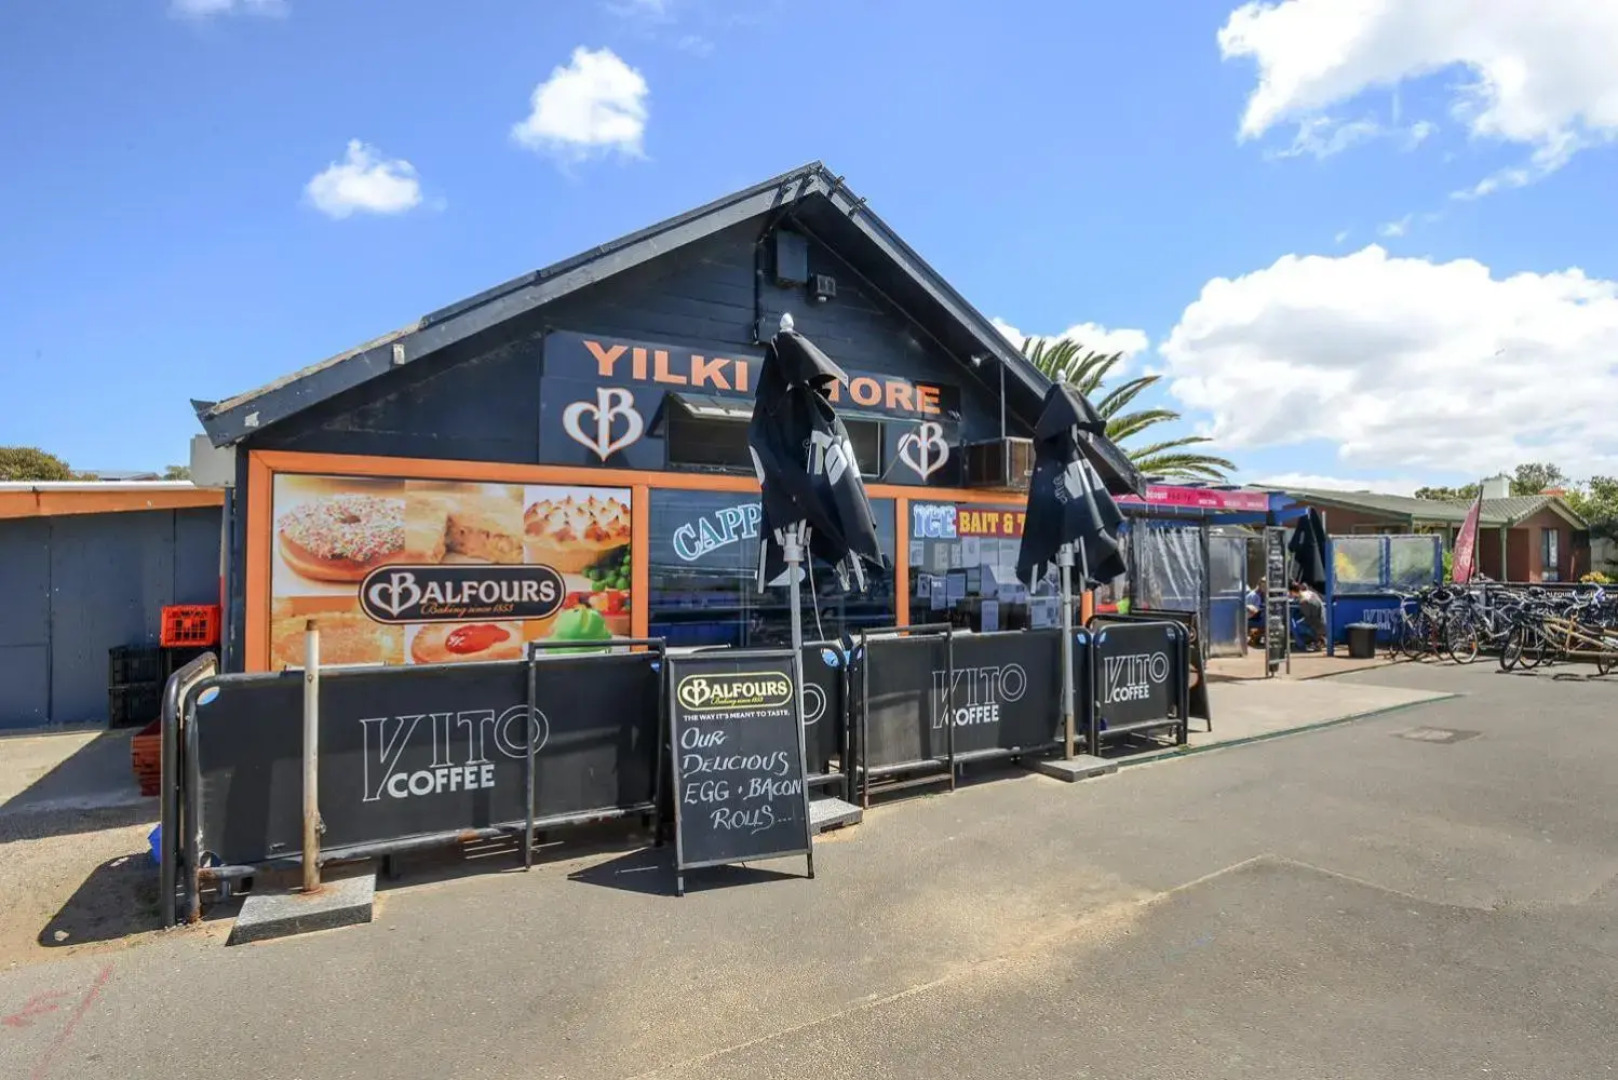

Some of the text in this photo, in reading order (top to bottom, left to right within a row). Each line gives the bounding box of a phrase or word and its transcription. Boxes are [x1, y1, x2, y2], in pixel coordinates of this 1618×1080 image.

[583, 340, 941, 415] YILKI TORE
[672, 502, 763, 561] CAPP
[914, 503, 957, 538] ICE
[959, 511, 998, 534] BAIT
[1003, 512, 1014, 534] &
[369, 572, 556, 618] BALFOURS
[420, 602, 467, 618] Baking
[682, 679, 788, 706] BALFOURS
[1104, 651, 1169, 704] VITO
[1113, 685, 1150, 702] COFFEE
[932, 663, 1027, 729] VITO
[360, 704, 550, 802] VITO
[682, 751, 790, 779] DELICIOUS
[386, 763, 495, 799] COFFEE
[684, 777, 803, 805] EGG BACON
